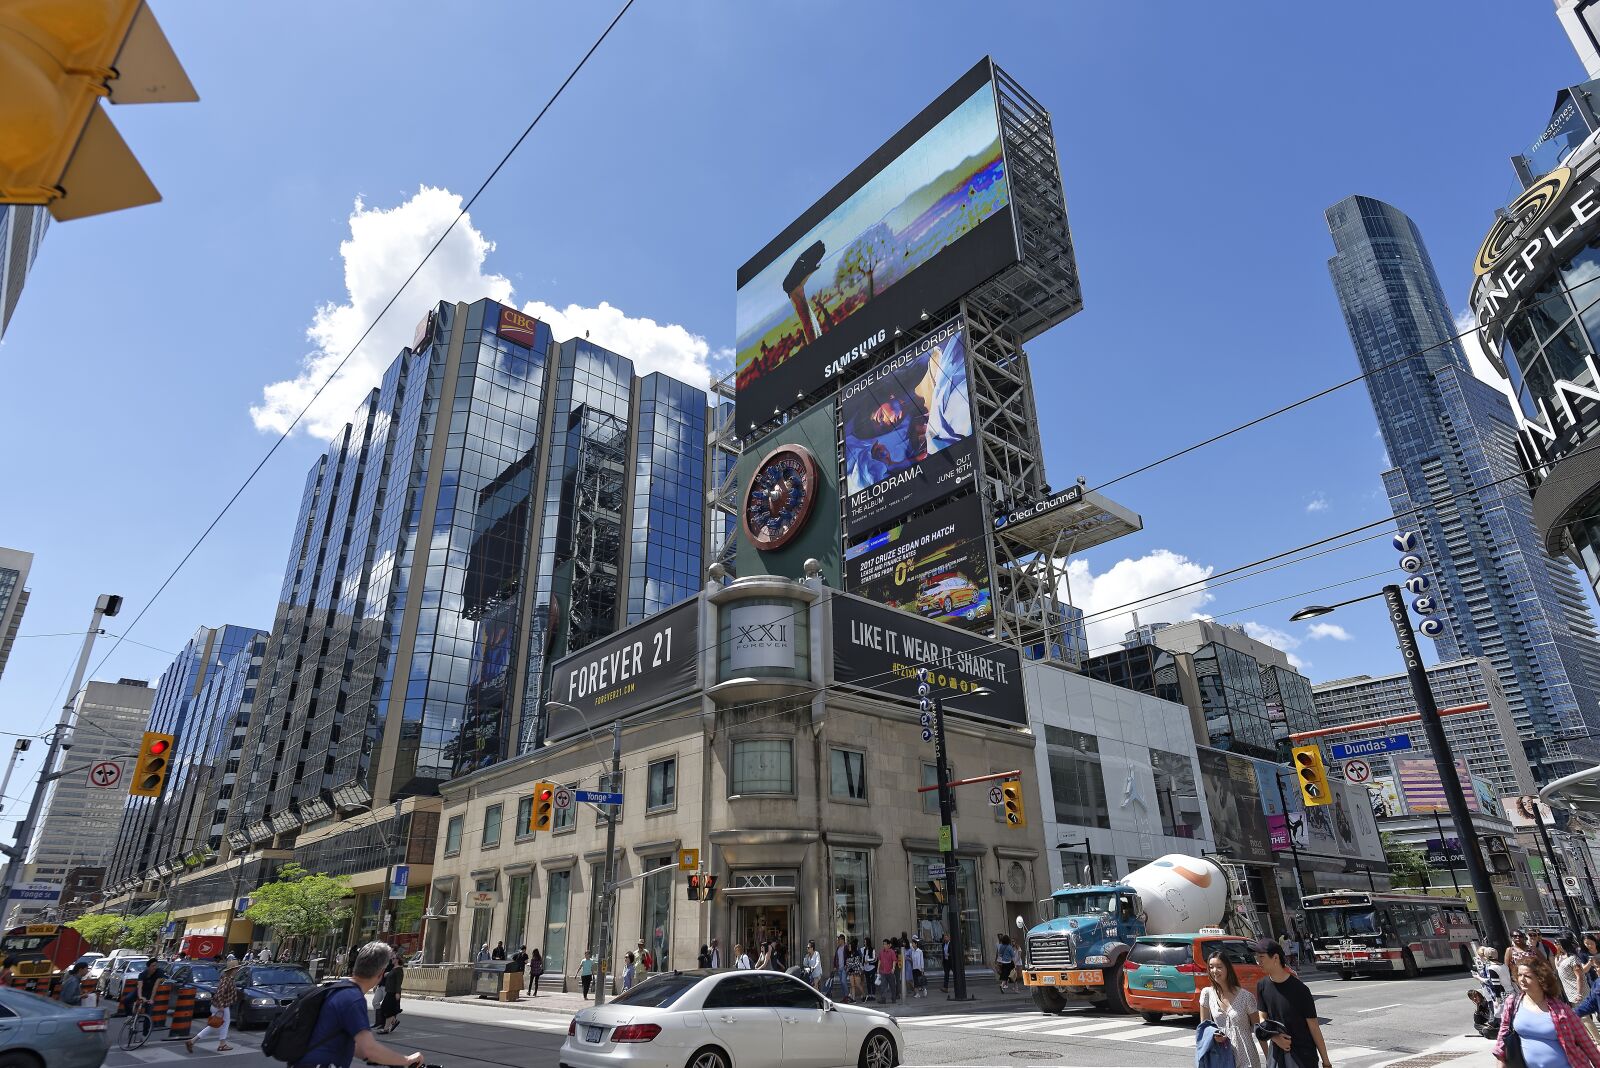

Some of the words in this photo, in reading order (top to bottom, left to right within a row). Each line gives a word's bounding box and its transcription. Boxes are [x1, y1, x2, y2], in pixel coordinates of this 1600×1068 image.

[1531, 104, 1572, 152] milestones
[1479, 189, 1600, 331] CINEPLE
[504, 311, 534, 331] CIBC
[825, 328, 886, 378] SAMSUNG
[842, 373, 874, 402] LORDE
[876, 352, 913, 380] LORDE
[915, 324, 955, 356] LORDE
[956, 453, 972, 466] OUT
[937, 469, 955, 484] JUNE
[955, 461, 972, 475] 16TH
[851, 464, 923, 508] MELODRAMA
[851, 508, 863, 517] THE
[864, 496, 884, 510] ALBUM
[1008, 508, 1034, 523] Clear
[1035, 488, 1077, 512] Channel
[860, 558, 874, 571] 2017
[875, 549, 896, 565] CRUZE
[897, 540, 920, 556] SEDAN
[921, 535, 930, 546] OR
[932, 523, 955, 541] HATCH
[1393, 531, 1441, 638] Yonge
[738, 624, 787, 643] XXI
[1387, 591, 1418, 668] DOWNTOWN
[736, 642, 788, 651] FOREVER
[851, 619, 882, 650] LIKE
[885, 629, 899, 655] IT.
[902, 634, 939, 665] WEAR
[942, 646, 955, 670] IT.
[957, 650, 994, 681] SHARE
[996, 661, 1009, 684] IT.
[569, 641, 643, 702] FOREVER
[652, 627, 672, 667] 21
[595, 683, 635, 706] FOREVER21.COM
[1344, 741, 1387, 755] Dundas
[587, 792, 607, 802] Yonge
[1271, 836, 1286, 844] THE
[743, 874, 775, 887] XXI
[1078, 972, 1101, 983] 435
